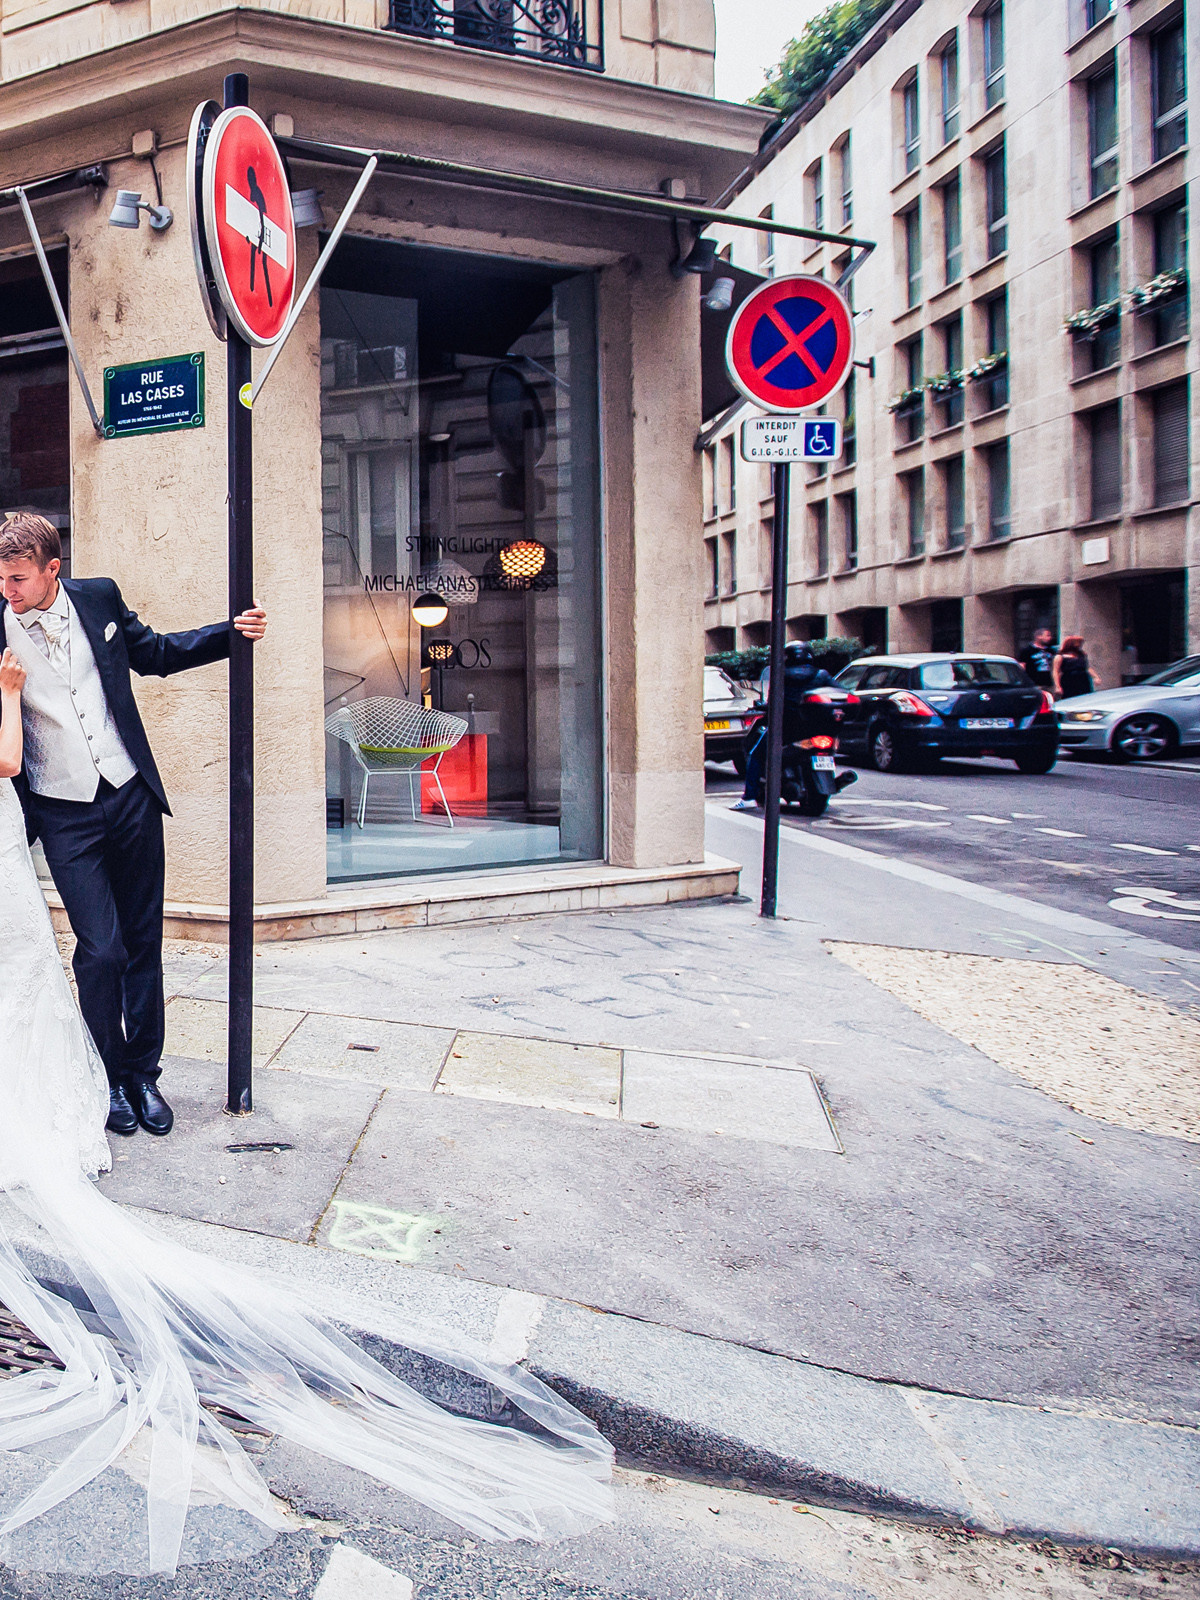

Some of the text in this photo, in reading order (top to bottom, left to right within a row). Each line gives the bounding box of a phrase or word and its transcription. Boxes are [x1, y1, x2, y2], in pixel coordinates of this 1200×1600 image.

[140, 370, 164, 385] RUE
[121, 384, 185, 405] LAS CASES
[756, 421, 797, 430] INTERDIT
[764, 434, 789, 443] SAUF
[751, 447, 801, 457] G.I.G.-G.I.C.
[405, 536, 458, 553] STRING
[365, 574, 431, 592] MICHAEL
